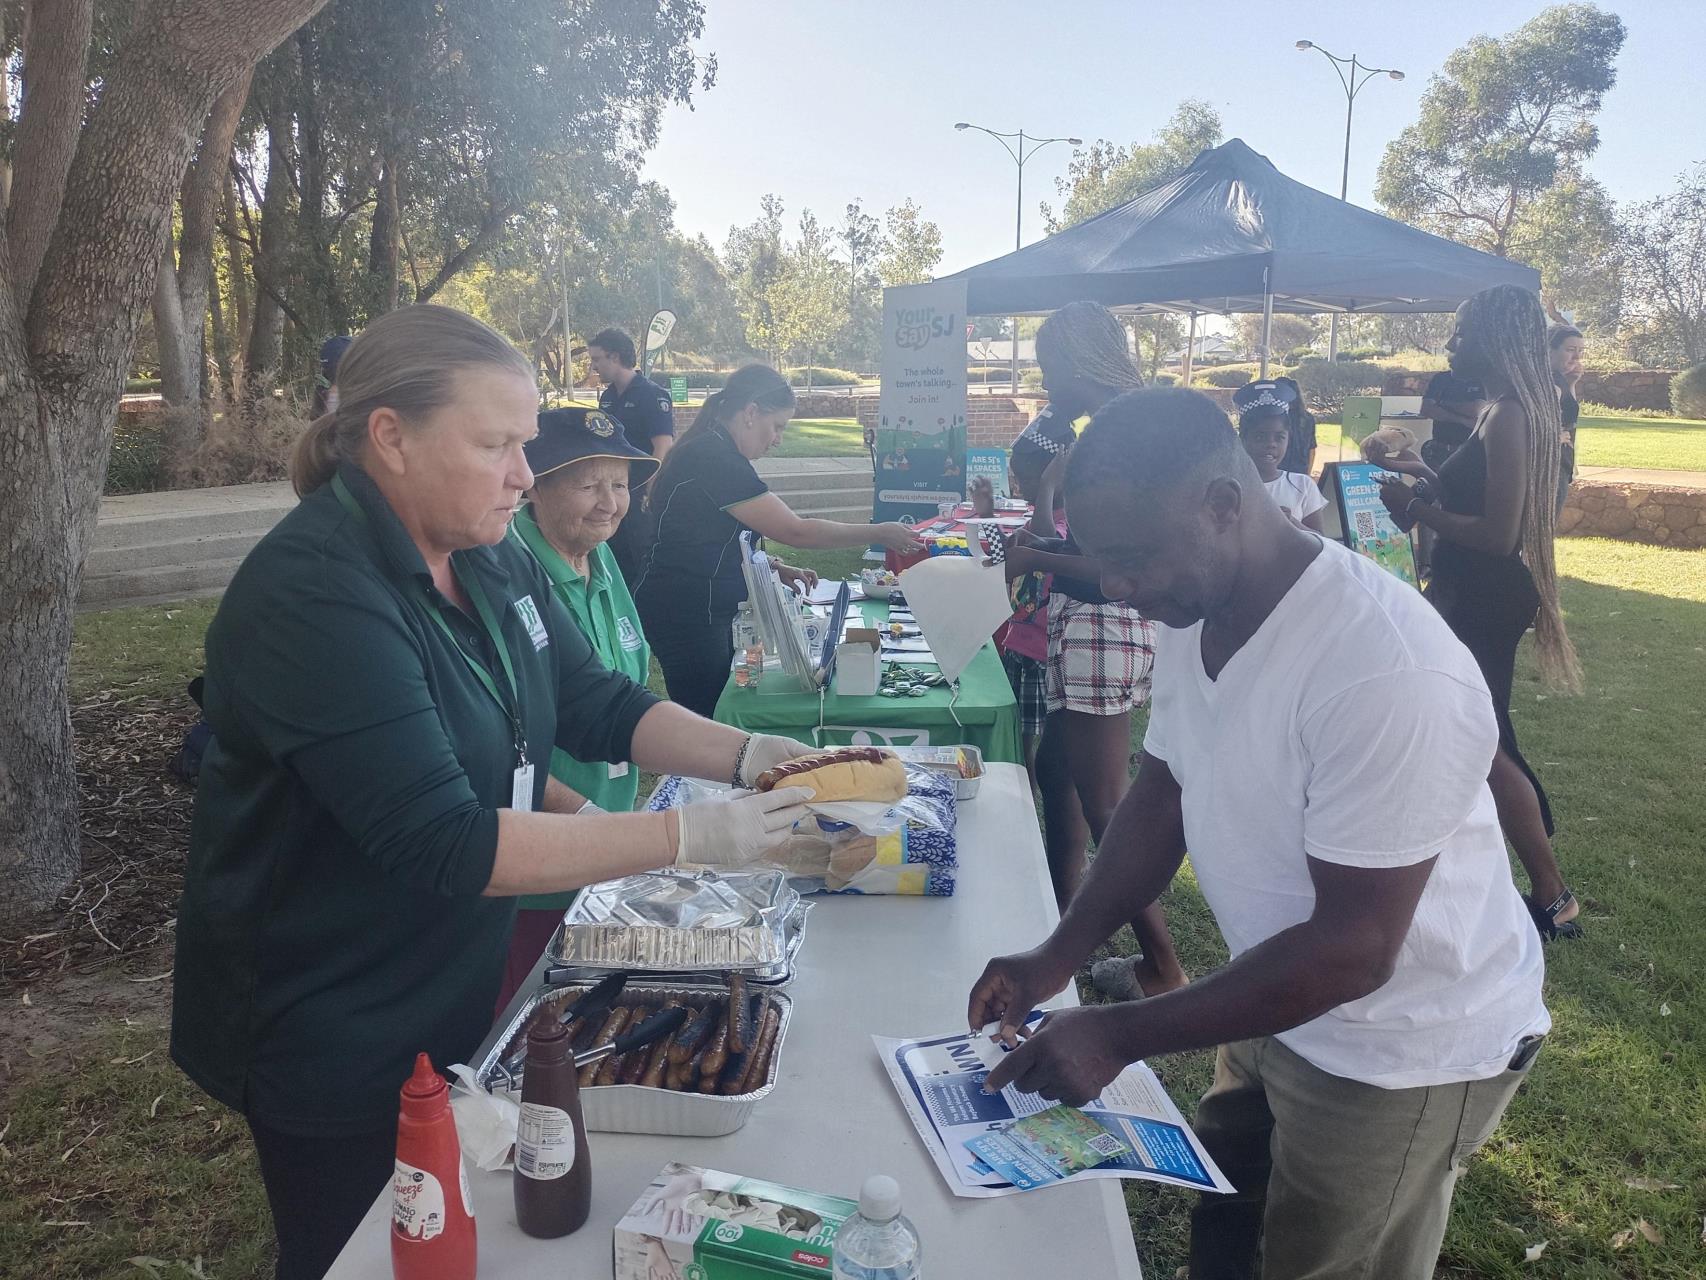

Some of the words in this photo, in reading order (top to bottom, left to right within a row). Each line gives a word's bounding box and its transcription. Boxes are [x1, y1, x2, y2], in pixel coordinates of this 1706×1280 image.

[932, 314, 954, 338] SJ
[904, 368, 919, 377] The
[921, 366, 944, 376] whole
[896, 380, 922, 388] town's
[908, 396, 927, 404] Join
[1346, 484, 1371, 496] GREEN
[1347, 498, 1364, 506] WELL
[941, 1088, 952, 1104] Firearms
[950, 1085, 961, 1103] Voluntary
[958, 1085, 969, 1100] Scheme
[958, 1104, 970, 1119] Reform
[967, 1102, 979, 1119] Buyback
[983, 1138, 1015, 1160] SPACES
[1013, 1161, 1041, 1181] GREEN
[394, 1184, 423, 1199] queeze
[395, 1200, 416, 1216] OMATO
[717, 1228, 740, 1240] 100
[799, 1253, 824, 1264] coles
